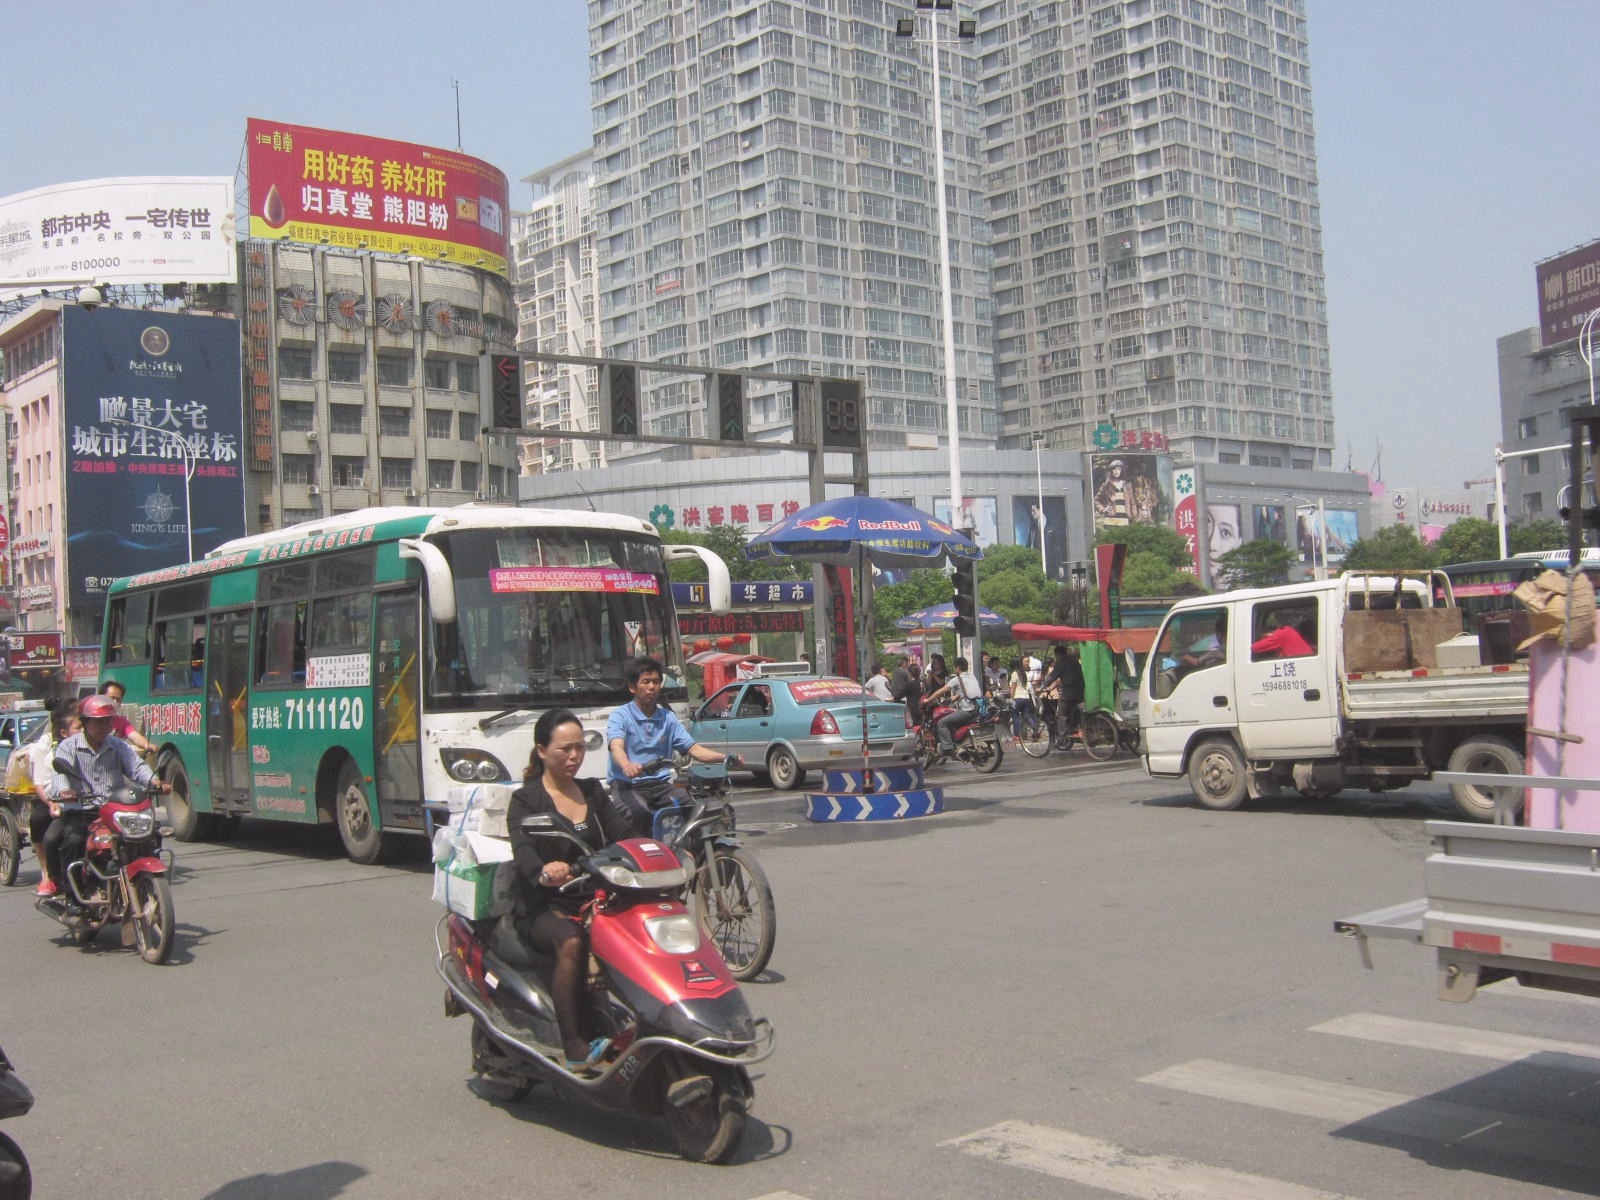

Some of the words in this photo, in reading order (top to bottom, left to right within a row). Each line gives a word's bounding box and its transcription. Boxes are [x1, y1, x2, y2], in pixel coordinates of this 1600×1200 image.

[302, 148, 374, 189] 用好药
[381, 159, 447, 199] 养好肝
[302, 184, 373, 220] 归真堂
[383, 194, 449, 231] 熊胆粉
[41, 209, 111, 238] 都市中央
[125, 207, 211, 228] 一宅传世
[71, 257, 120, 271] 8100000
[71, 425, 238, 462] 城市生活坐标
[131, 523, 165, 533] KING'S
[168, 524, 187, 534] LIFE
[858, 519, 921, 531] RedBull
[1270, 662, 1296, 678] 上饶
[1262, 680, 1308, 691] 15946881018
[285, 696, 364, 730] 7111120
